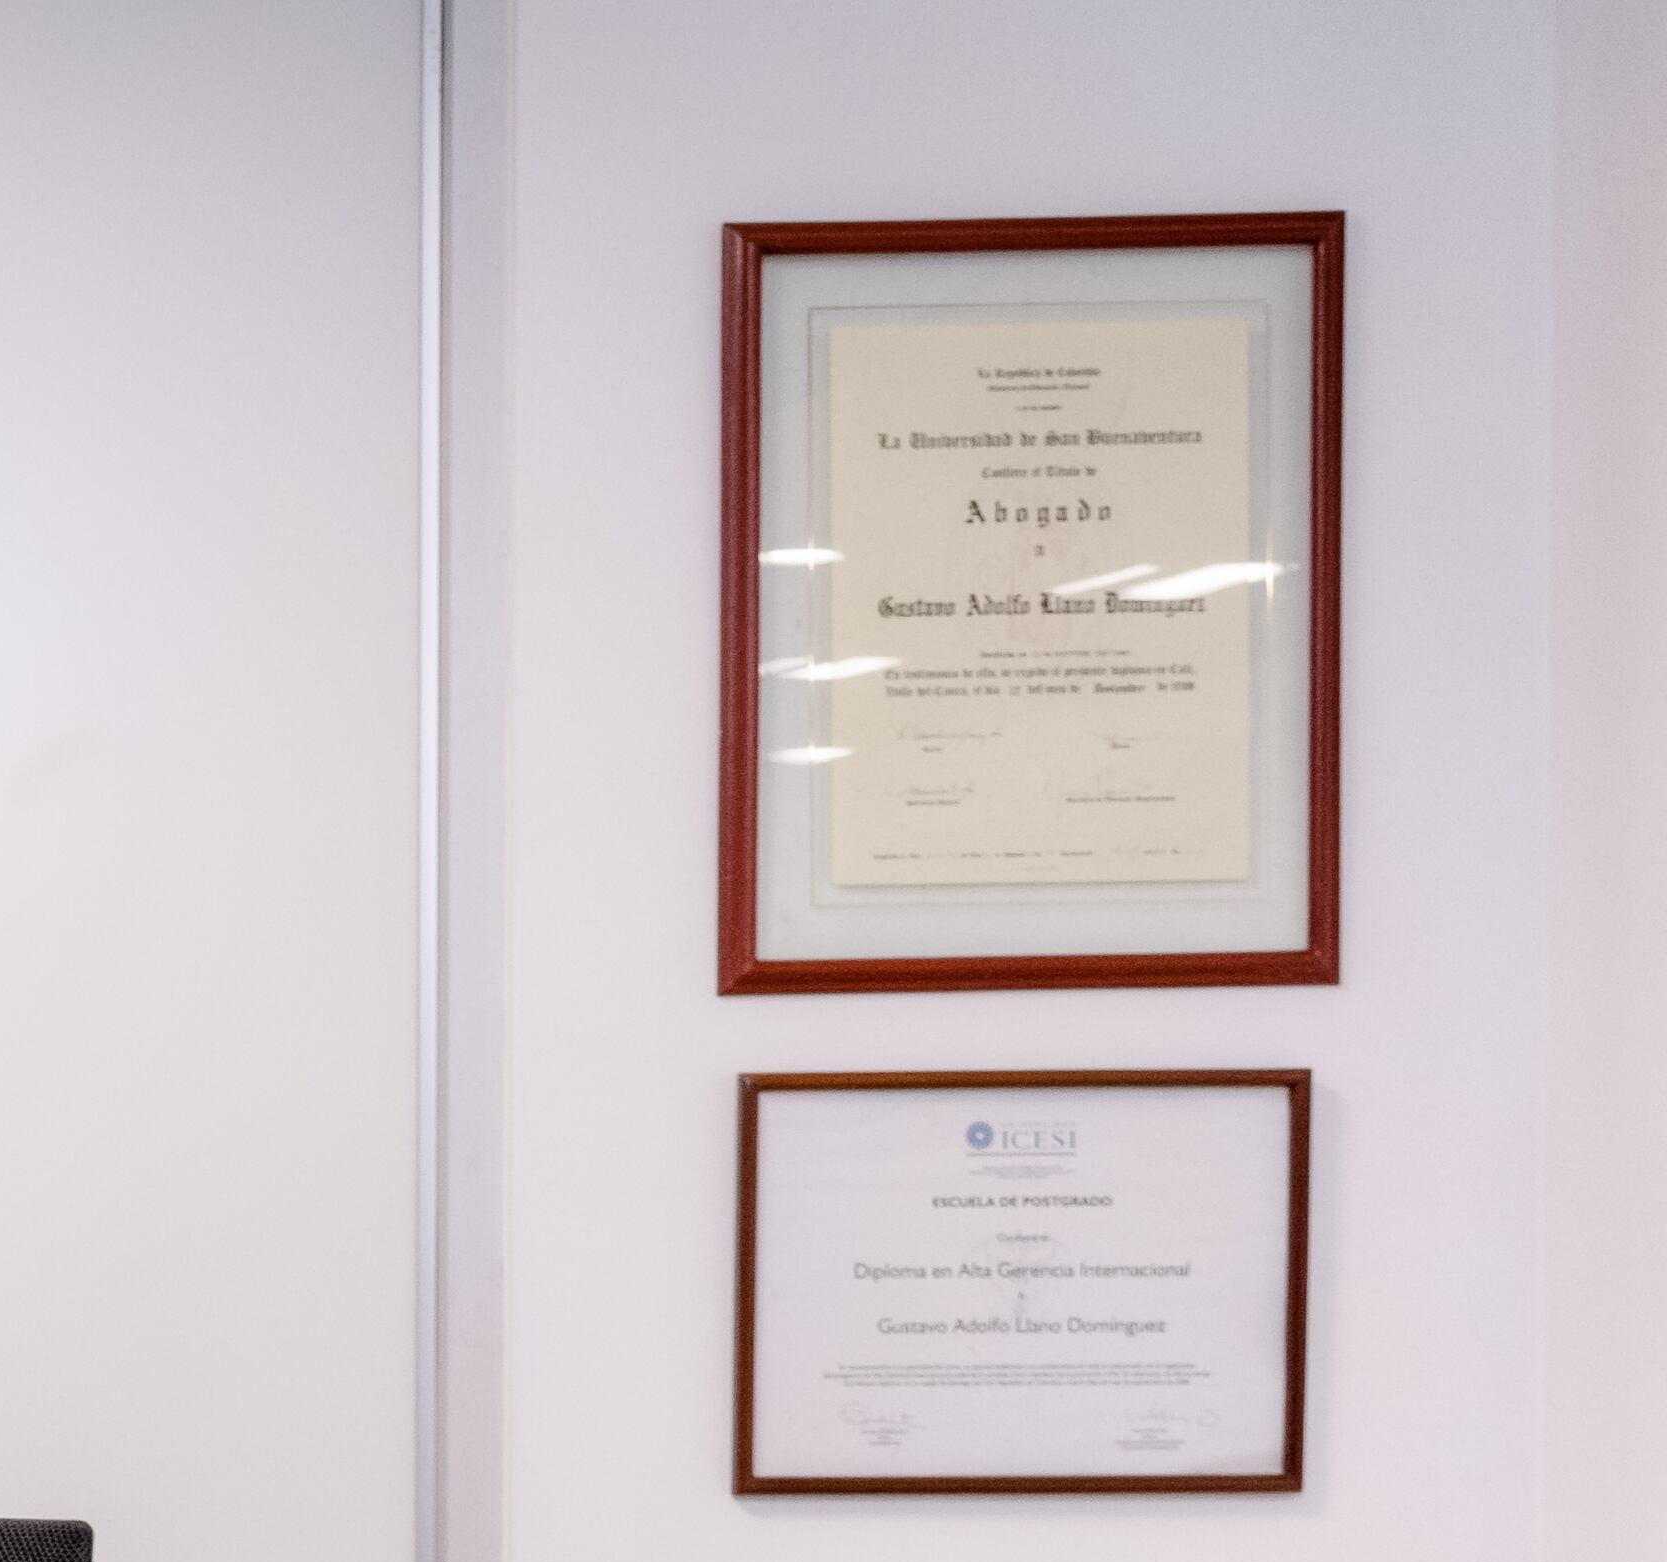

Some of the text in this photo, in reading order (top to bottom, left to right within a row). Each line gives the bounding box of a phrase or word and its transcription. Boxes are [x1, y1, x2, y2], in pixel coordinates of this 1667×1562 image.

[910, 431, 1012, 449] Universidad
[965, 499, 1111, 527] Abogado
[967, 593, 1031, 616] Adolfo
[1002, 1130, 1076, 1149] ICESI
[932, 1196, 995, 1208] ESCUELA
[999, 1196, 1018, 1207] DE
[853, 1261, 1191, 1280] Diploma en Alta Gerencia Internacional
[877, 1318, 947, 1334] Gustavo
[953, 1317, 1010, 1333] Adolfo
[1015, 1317, 1061, 1333] Llano
